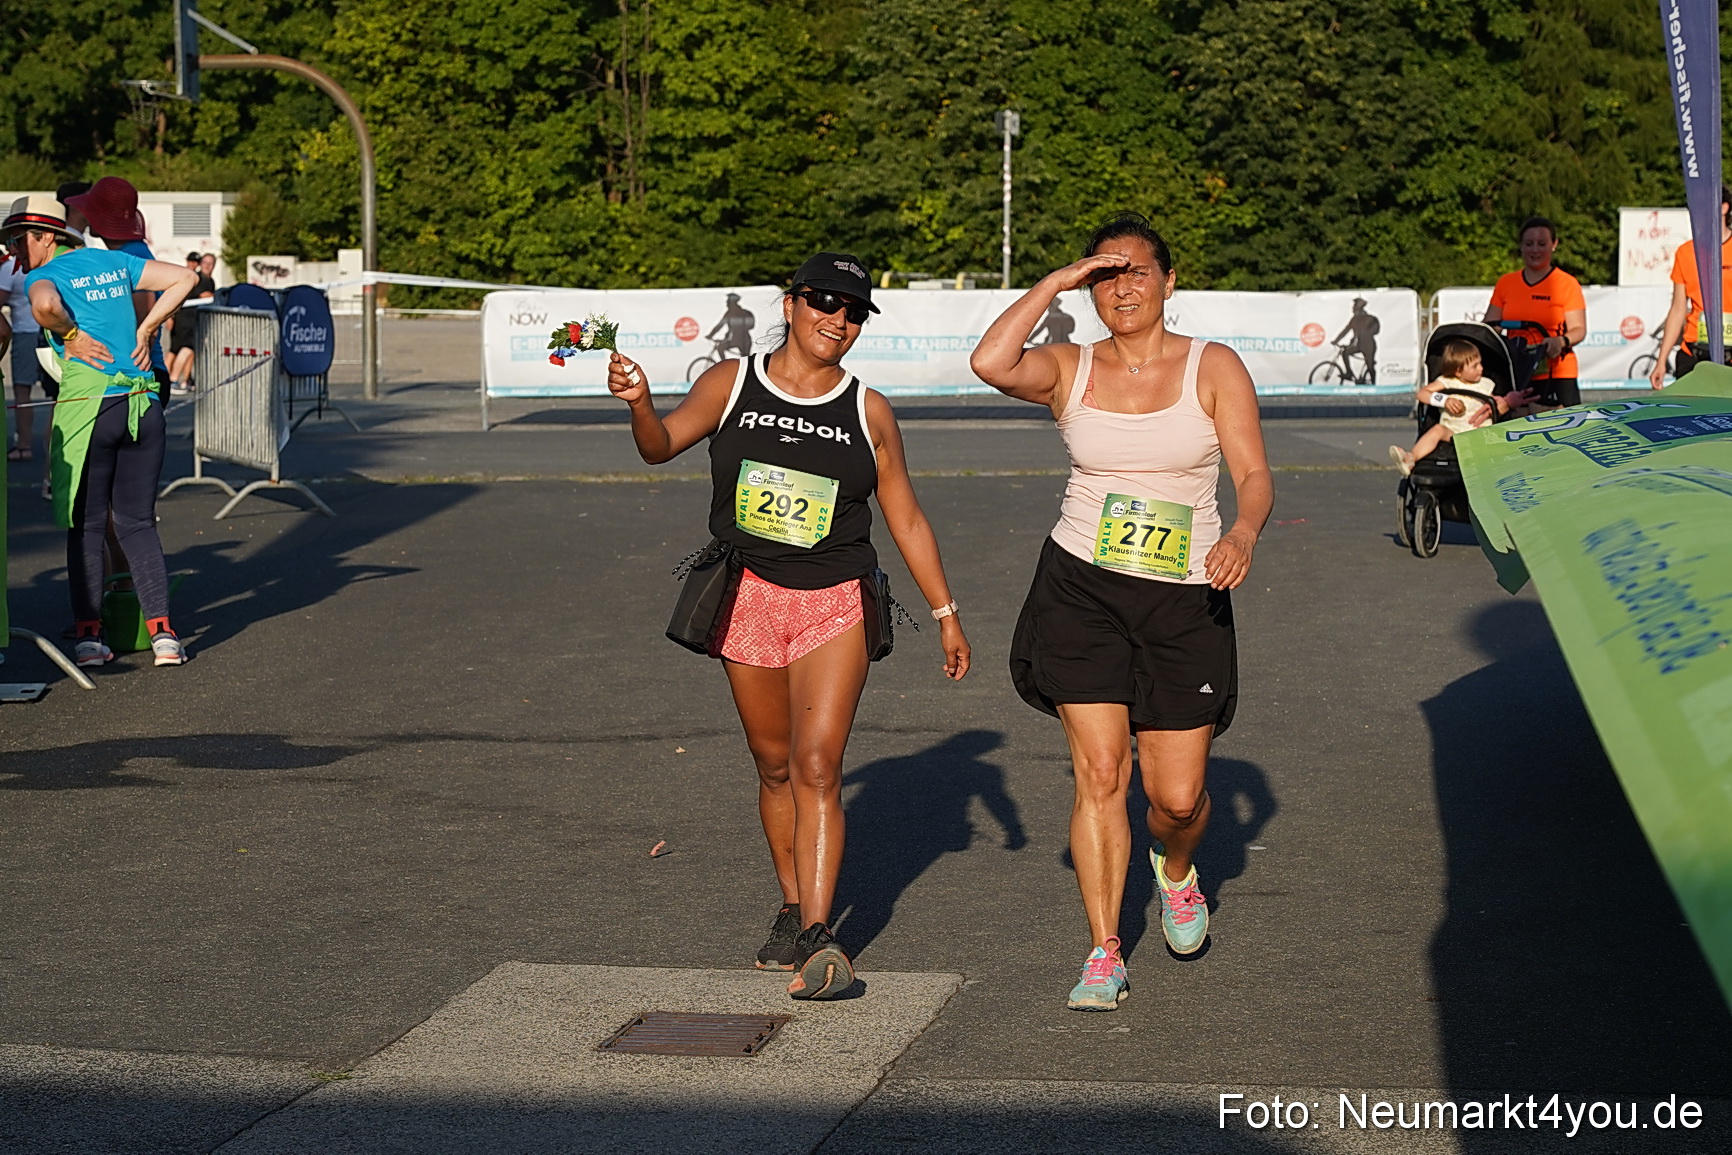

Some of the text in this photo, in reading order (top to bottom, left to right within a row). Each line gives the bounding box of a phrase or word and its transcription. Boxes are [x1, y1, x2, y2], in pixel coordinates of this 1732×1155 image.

[70, 276, 91, 289] Hier
[93, 270, 119, 285] blüht
[509, 312, 548, 326] NOW
[290, 322, 327, 342] Fischer
[738, 411, 852, 446] Reebok
[763, 478, 795, 489] Firmenlauf
[740, 488, 750, 522] WALK
[757, 490, 809, 523] 292
[1125, 509, 1157, 519] Firmenlauf
[766, 516, 775, 525] de
[775, 519, 799, 530] Krieger
[799, 523, 812, 532] Ana
[768, 524, 789, 535] Cecilia
[814, 507, 829, 540] 2022
[1099, 521, 1113, 557] WALK
[1119, 521, 1172, 551] 277
[1108, 544, 1178, 565] Klausnitzer Mandy
[1176, 535, 1188, 569] 2022
